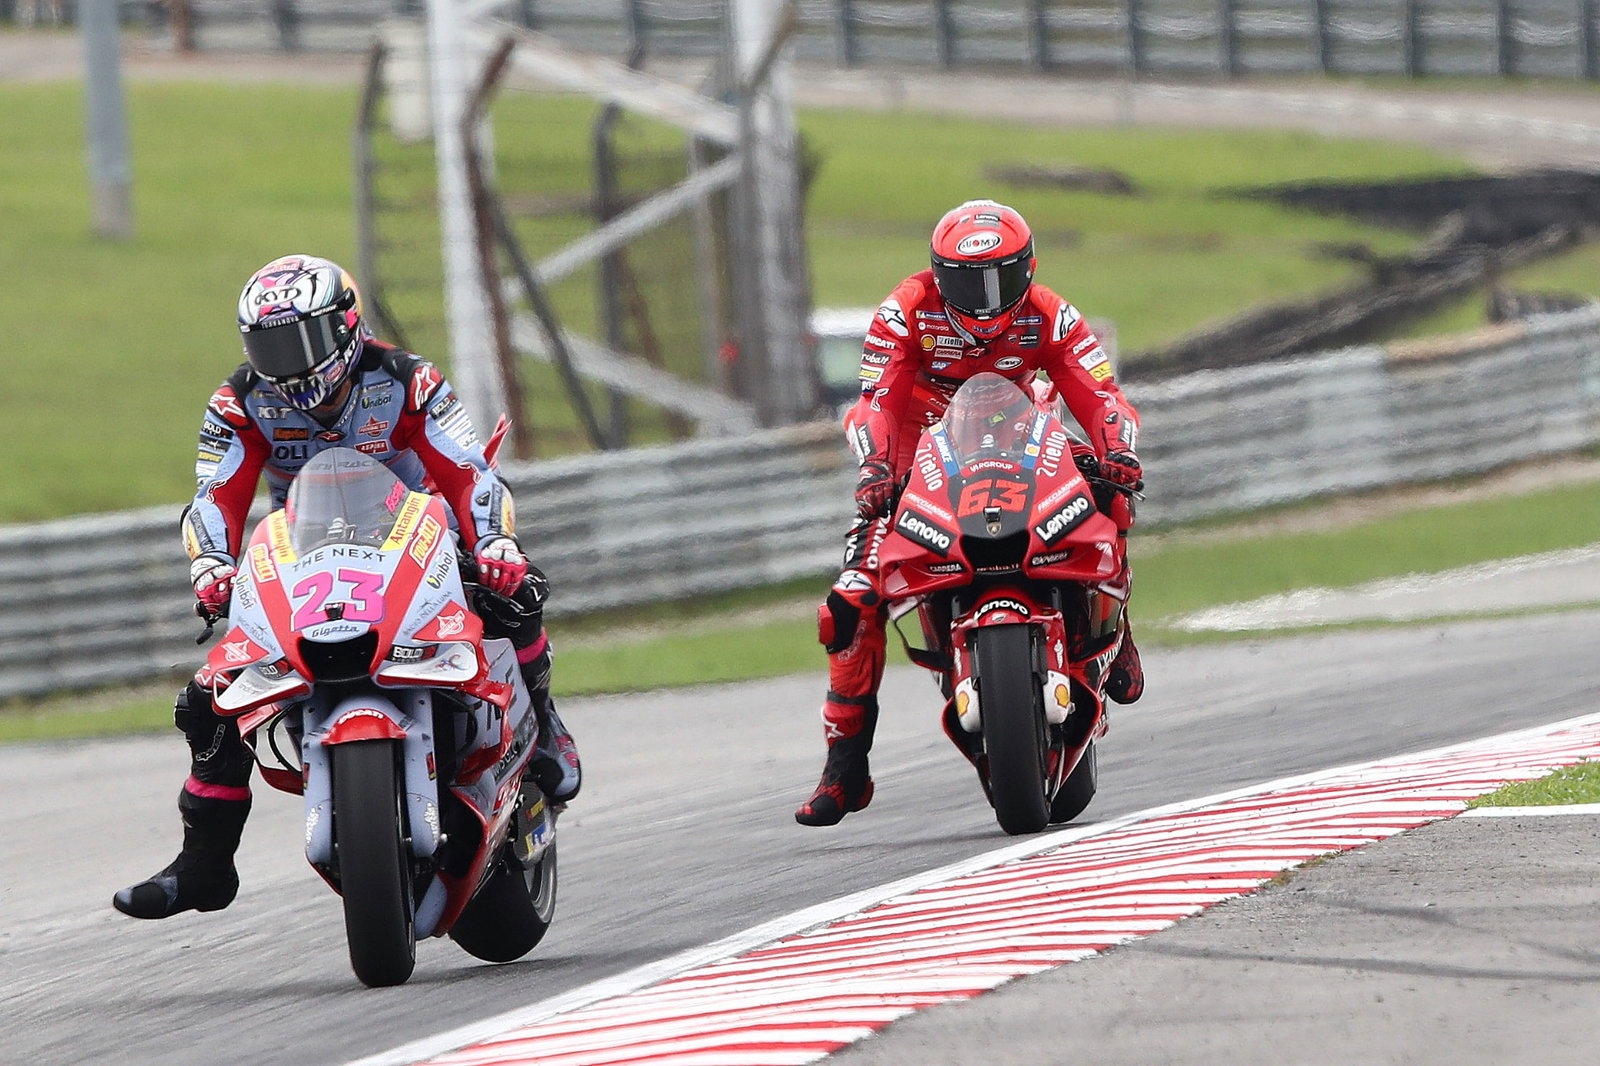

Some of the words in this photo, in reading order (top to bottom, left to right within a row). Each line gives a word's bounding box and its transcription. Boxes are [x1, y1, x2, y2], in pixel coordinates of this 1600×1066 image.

[961, 237, 998, 250] SUOMY
[865, 334, 896, 350] DUCATI
[931, 361, 947, 370] SAP
[273, 444, 309, 460] OLI
[957, 479, 1030, 518] 63
[390, 496, 421, 545] Antangin
[898, 510, 950, 550] Lenovo
[1035, 496, 1089, 542] Lenovo
[293, 553, 325, 572] THE
[332, 547, 387, 562] NEXT
[427, 552, 454, 590] Unibat
[235, 574, 255, 611] Unibat
[291, 568, 385, 632] 23
[974, 600, 1029, 620] Lenovo
